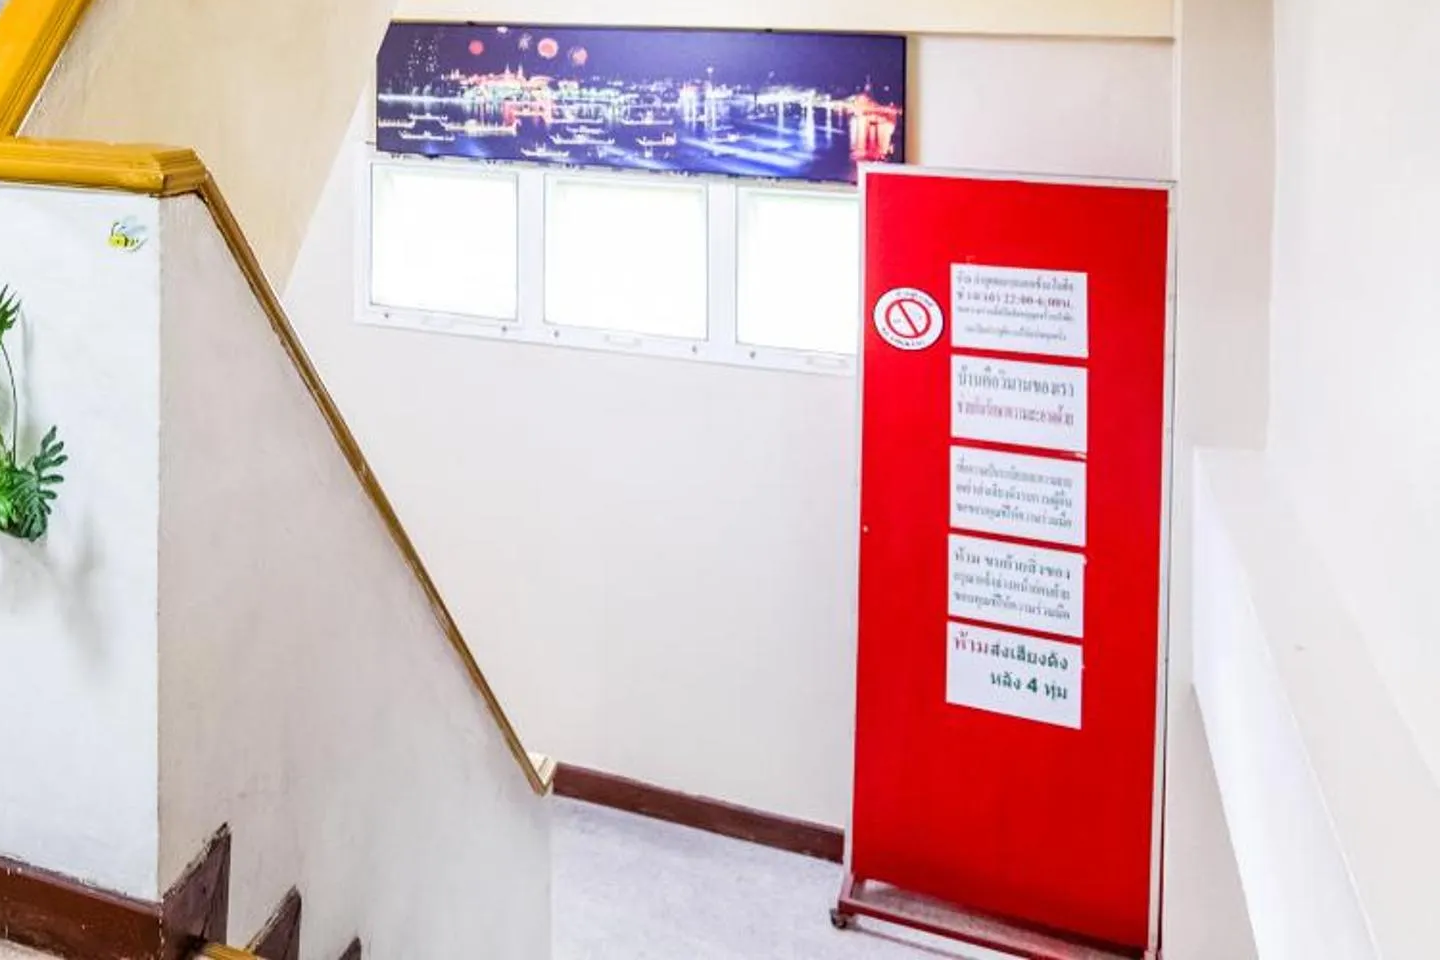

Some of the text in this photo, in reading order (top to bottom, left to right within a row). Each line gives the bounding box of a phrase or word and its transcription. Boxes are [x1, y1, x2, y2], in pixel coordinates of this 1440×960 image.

[990, 671, 1068, 701] หลัง 4 ทุ่ม
